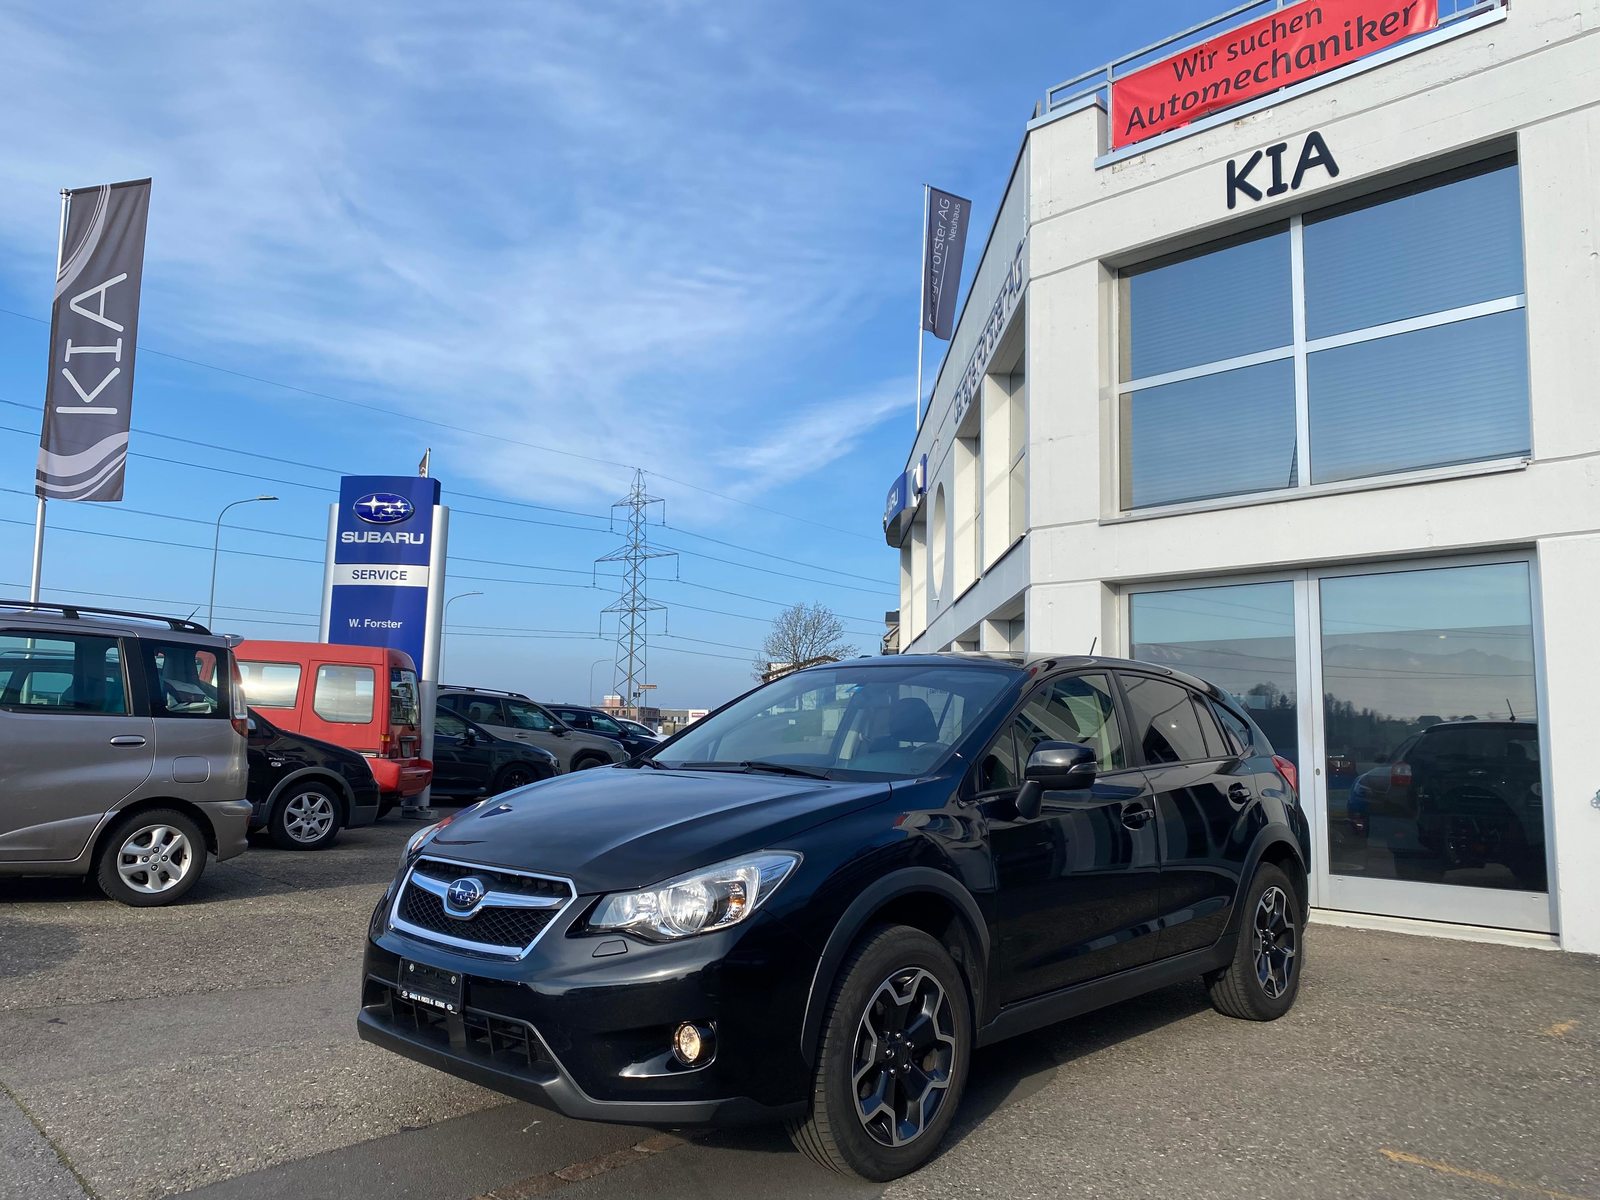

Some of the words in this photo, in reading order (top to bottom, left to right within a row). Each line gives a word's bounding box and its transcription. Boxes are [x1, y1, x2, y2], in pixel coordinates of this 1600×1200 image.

[1172, 50, 1218, 82] Wir
[1226, 6, 1323, 62] suchen
[1124, 0, 1418, 136] Automechaniker
[1226, 130, 1340, 210] KIA
[938, 197, 950, 221] AG
[948, 203, 960, 241] Neuhaus
[55, 272, 128, 415] KIA
[341, 531, 424, 545] SUBARU
[351, 569, 408, 581] SERVICE
[348, 618, 361, 629] W.
[364, 618, 403, 629] Forster
